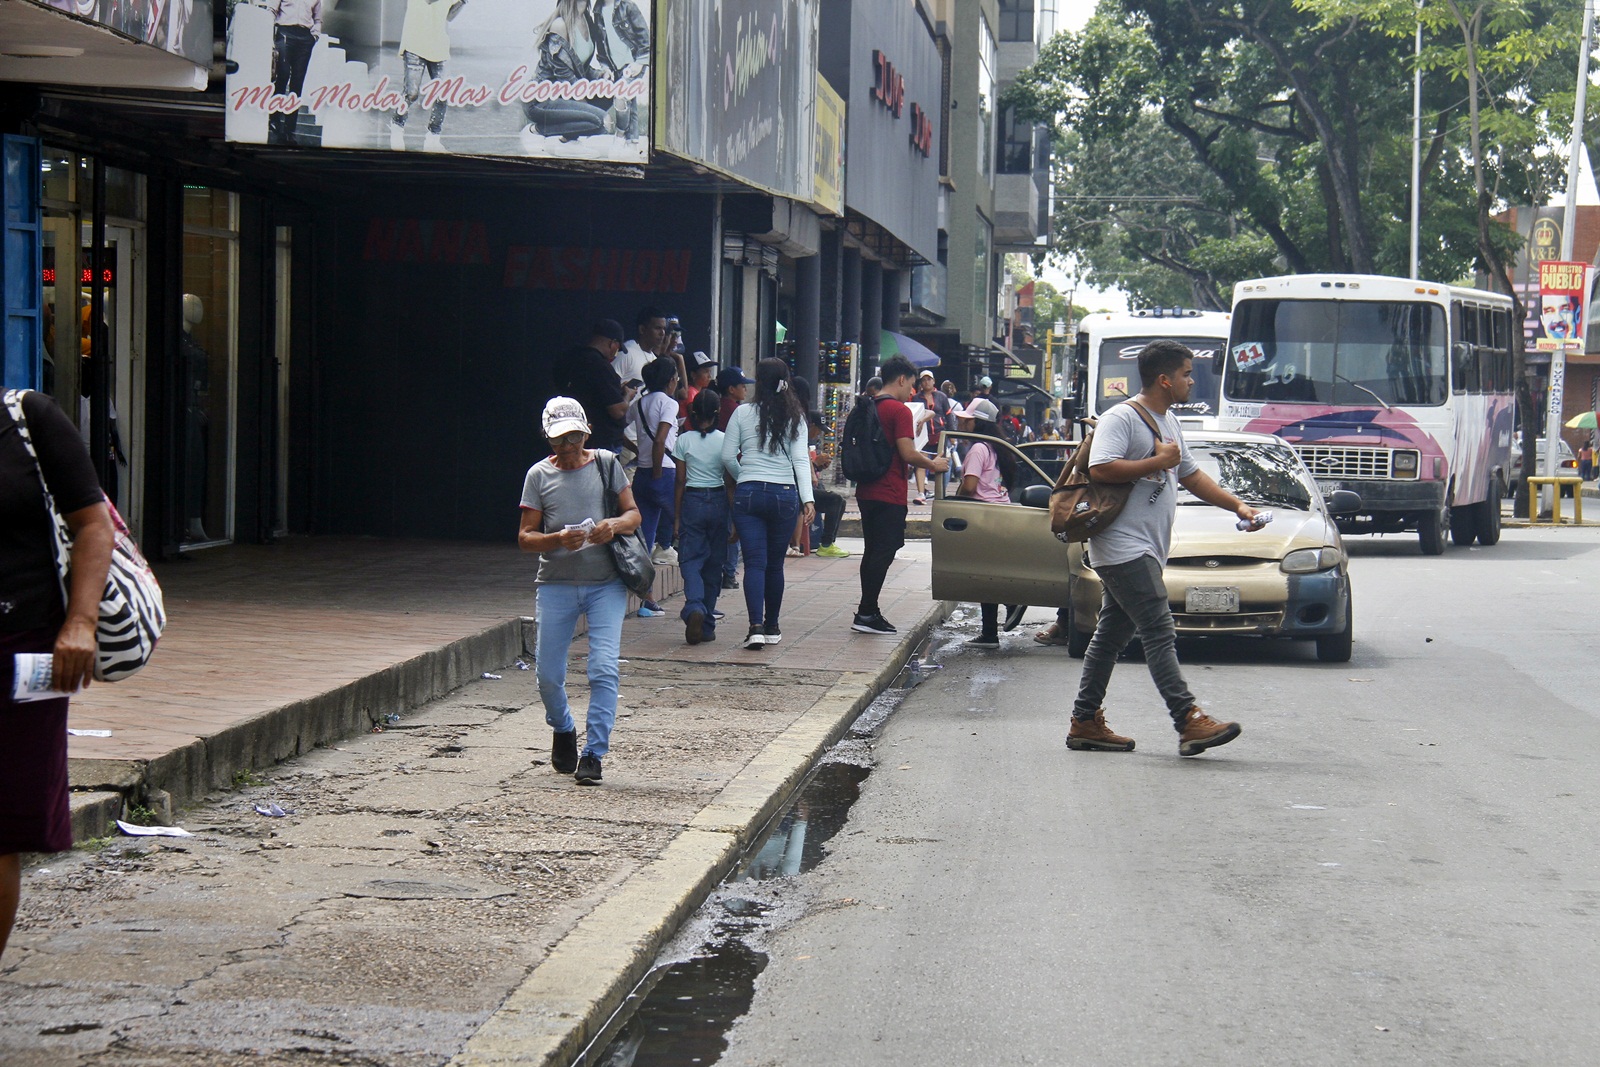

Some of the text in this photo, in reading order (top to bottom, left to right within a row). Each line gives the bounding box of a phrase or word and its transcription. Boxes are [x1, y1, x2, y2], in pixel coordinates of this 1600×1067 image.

[231, 83, 302, 112] Mas
[309, 76, 407, 112] Moda,
[422, 76, 492, 107] Mas
[363, 217, 491, 265] NANA
[503, 243, 693, 293] FASHION
[1549, 264, 1557, 273] EN
[1557, 264, 1583, 274] NUESTRO
[1541, 273, 1583, 290] PUEBLO
[1236, 344, 1263, 364] 41
[1107, 380, 1125, 390] 40
